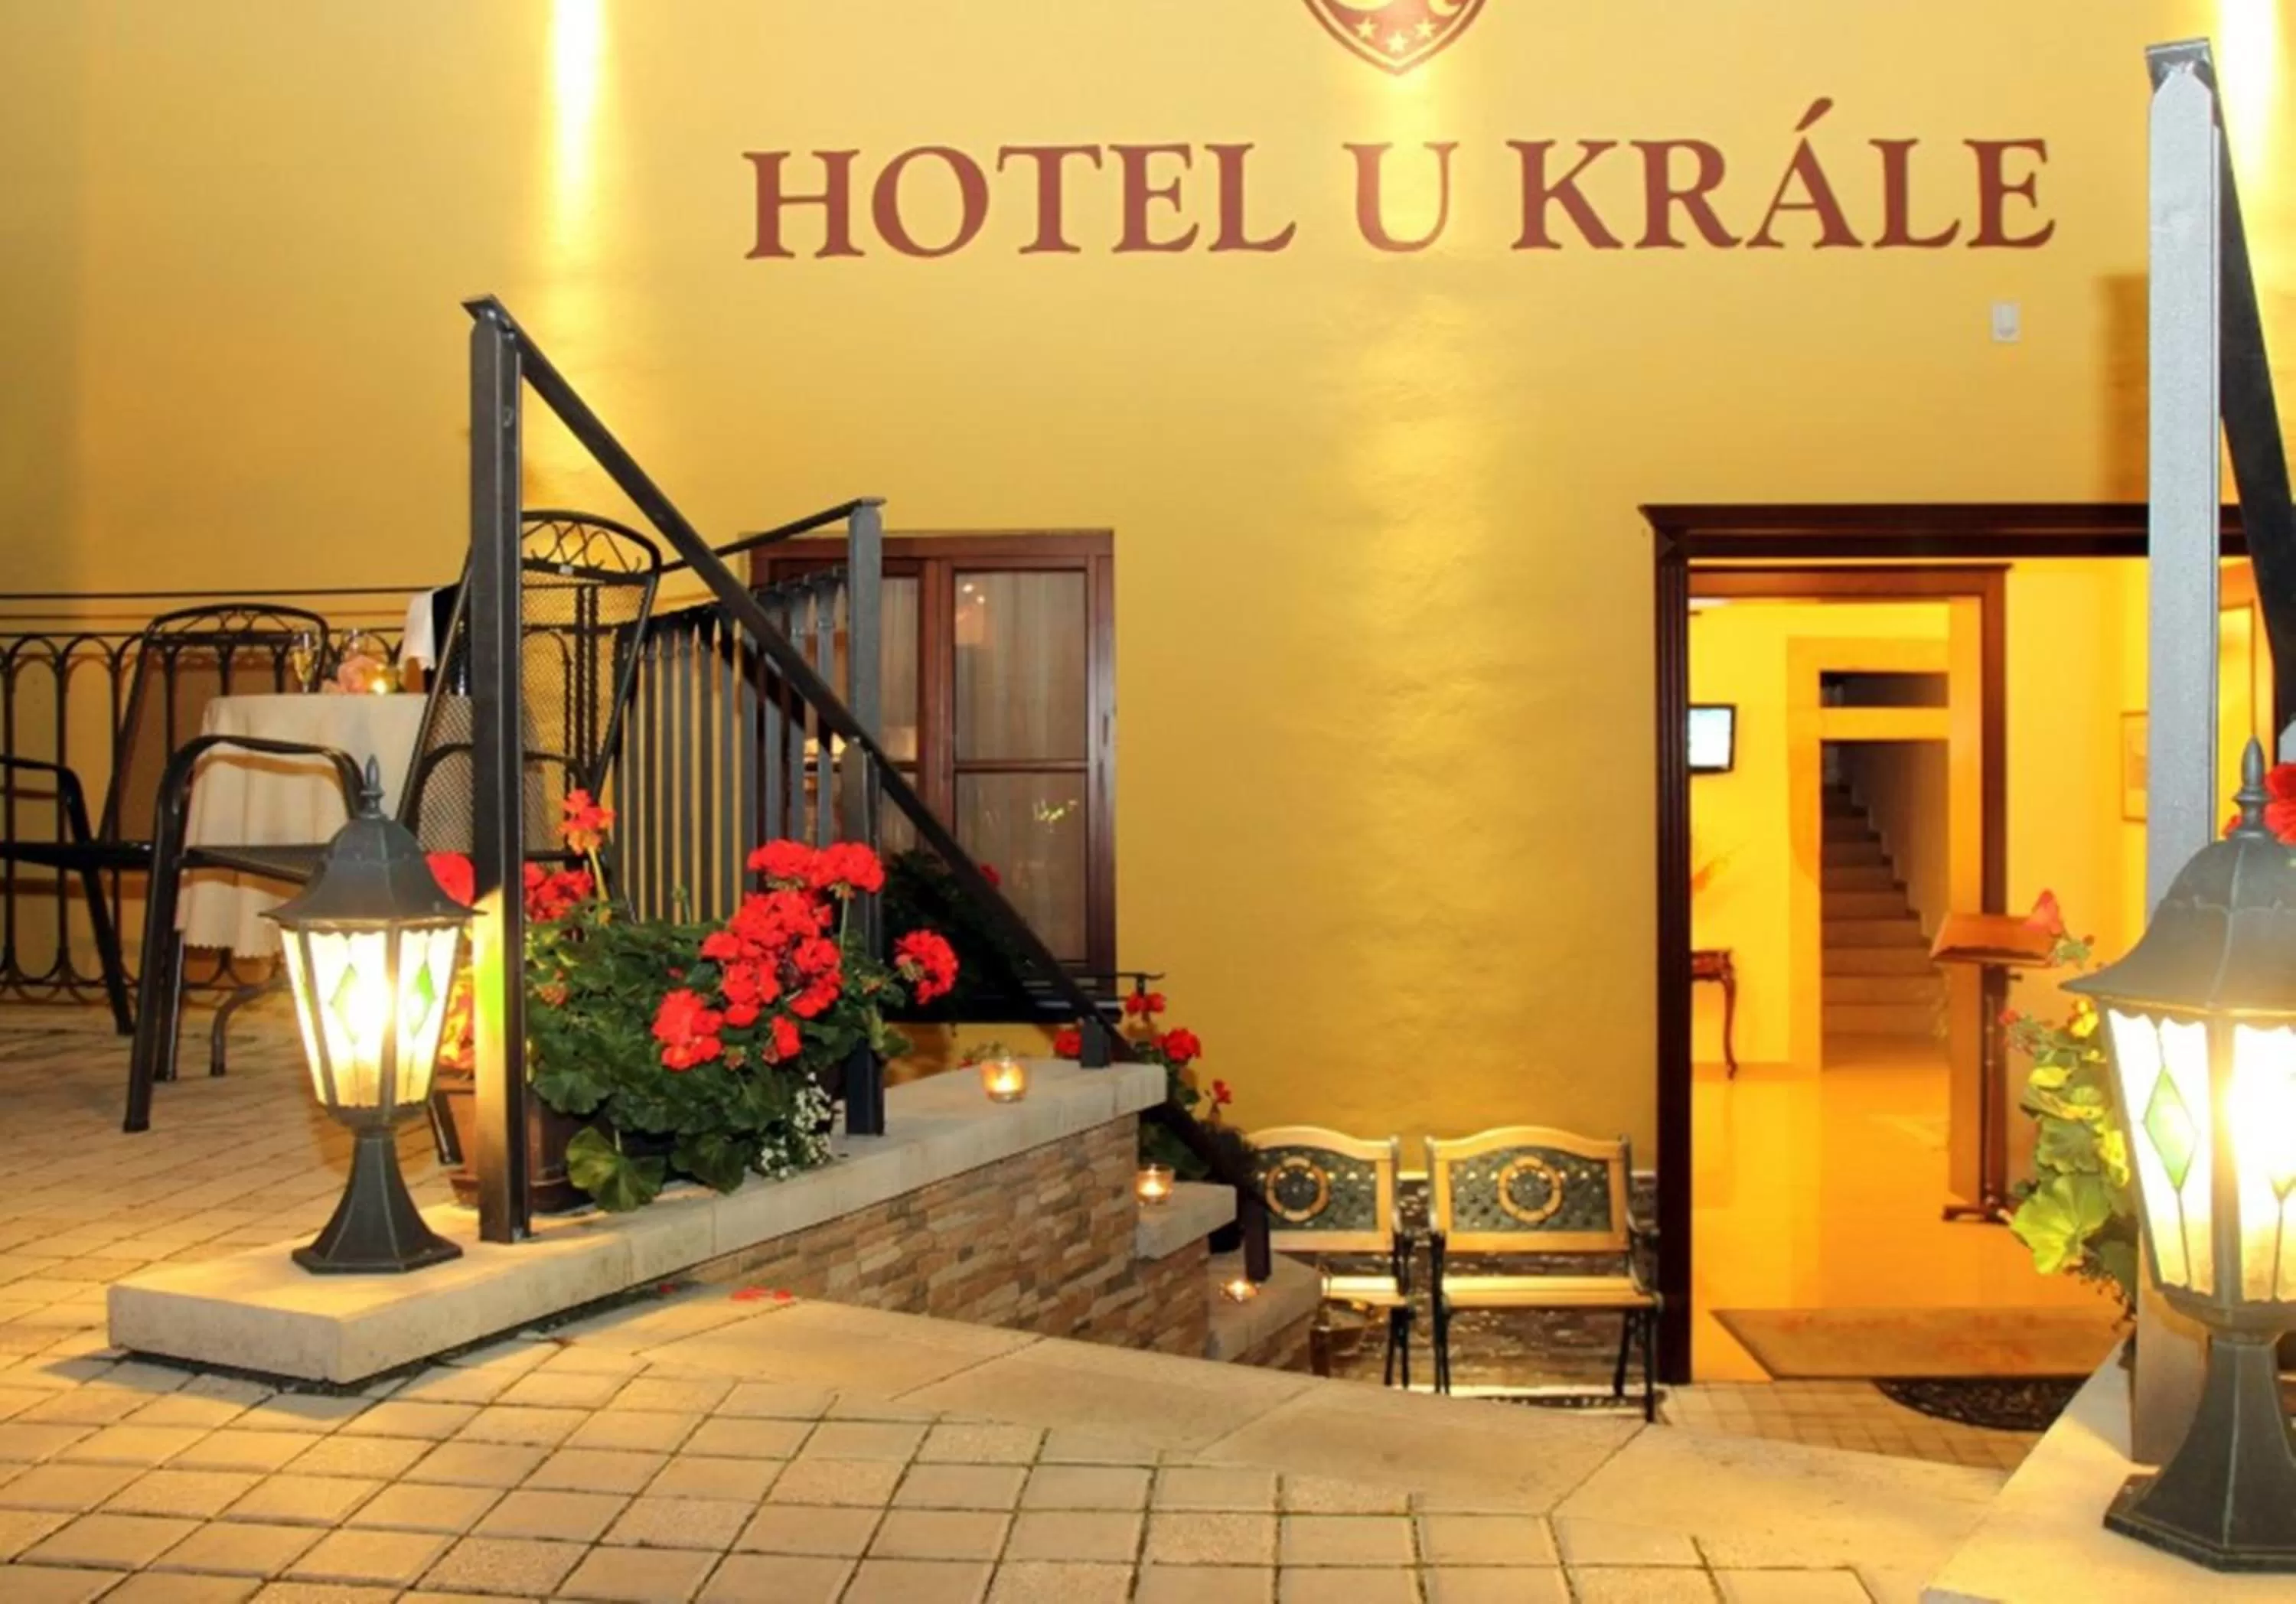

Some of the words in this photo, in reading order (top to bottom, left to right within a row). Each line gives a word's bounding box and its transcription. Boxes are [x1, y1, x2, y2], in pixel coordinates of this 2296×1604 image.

[742, 143, 1296, 259] HOTEL
[1344, 143, 1459, 252] U
[1506, 97, 2055, 249] KRÁLE
